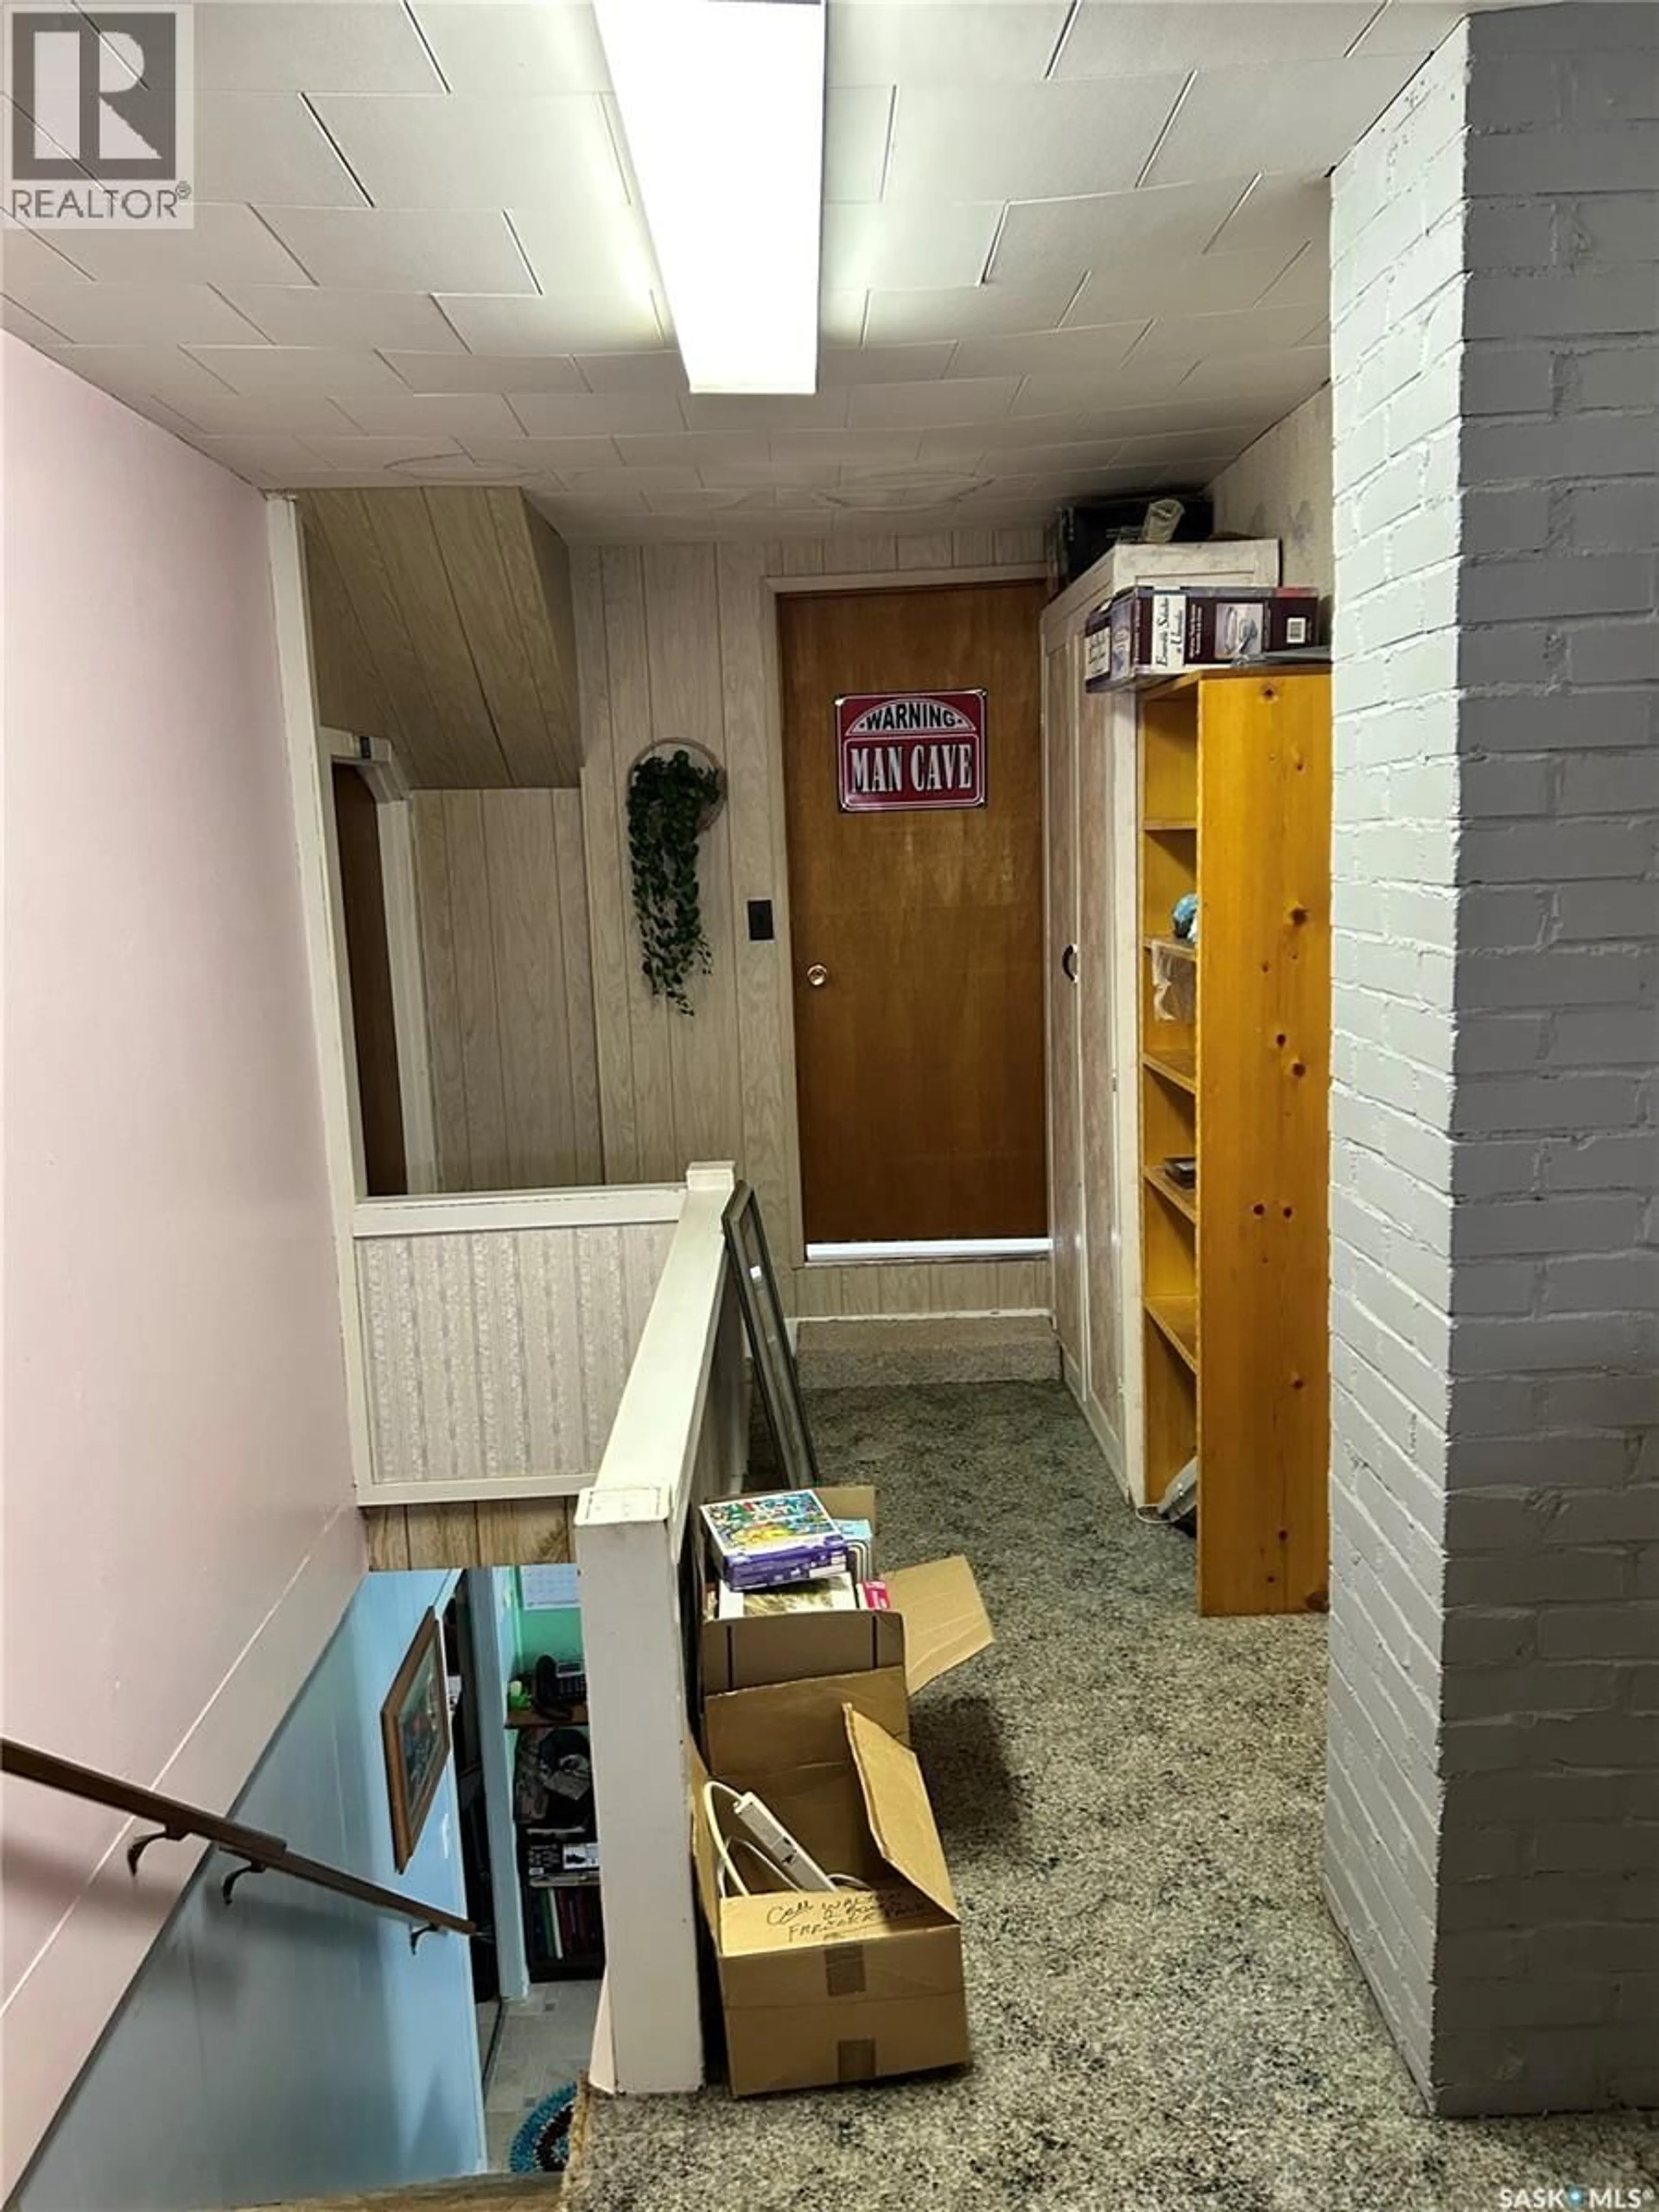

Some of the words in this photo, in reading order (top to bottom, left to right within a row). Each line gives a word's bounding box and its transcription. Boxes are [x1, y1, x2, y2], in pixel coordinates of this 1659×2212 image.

[866, 702, 956, 731] WARNING
[851, 747, 902, 792] MAN
[911, 744, 972, 791] CAVE
